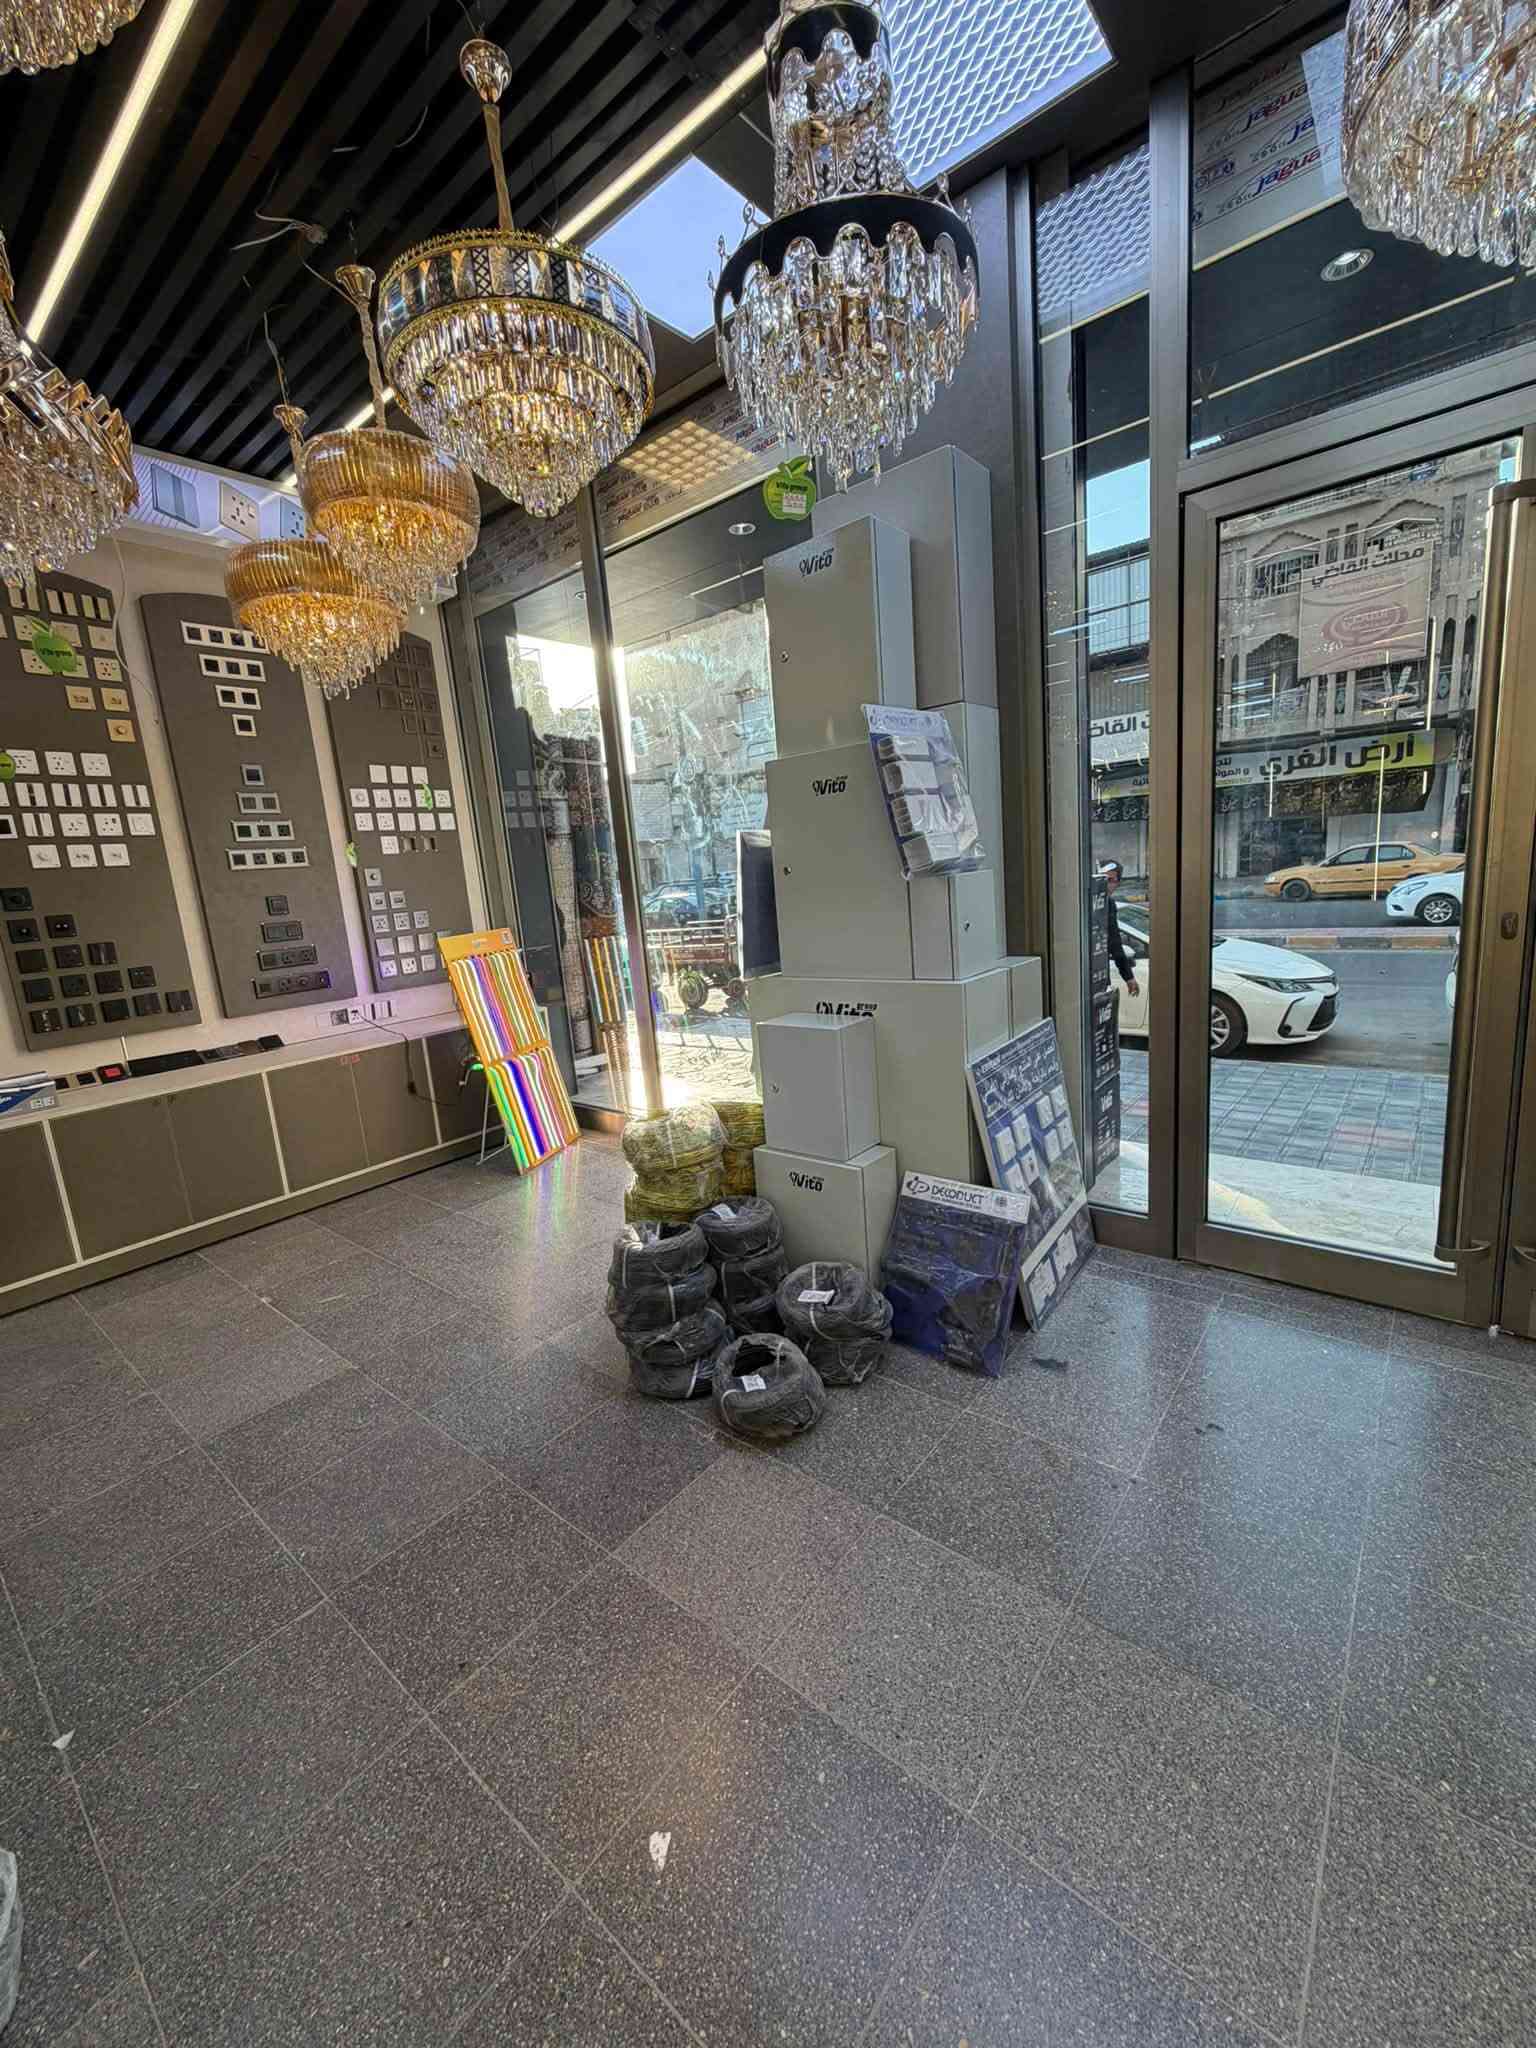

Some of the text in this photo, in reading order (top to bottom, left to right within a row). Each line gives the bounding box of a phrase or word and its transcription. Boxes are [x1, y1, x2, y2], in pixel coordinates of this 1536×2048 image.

[1311, 547, 1425, 590] محلات القاضي
[1090, 716, 1137, 738] القاض
